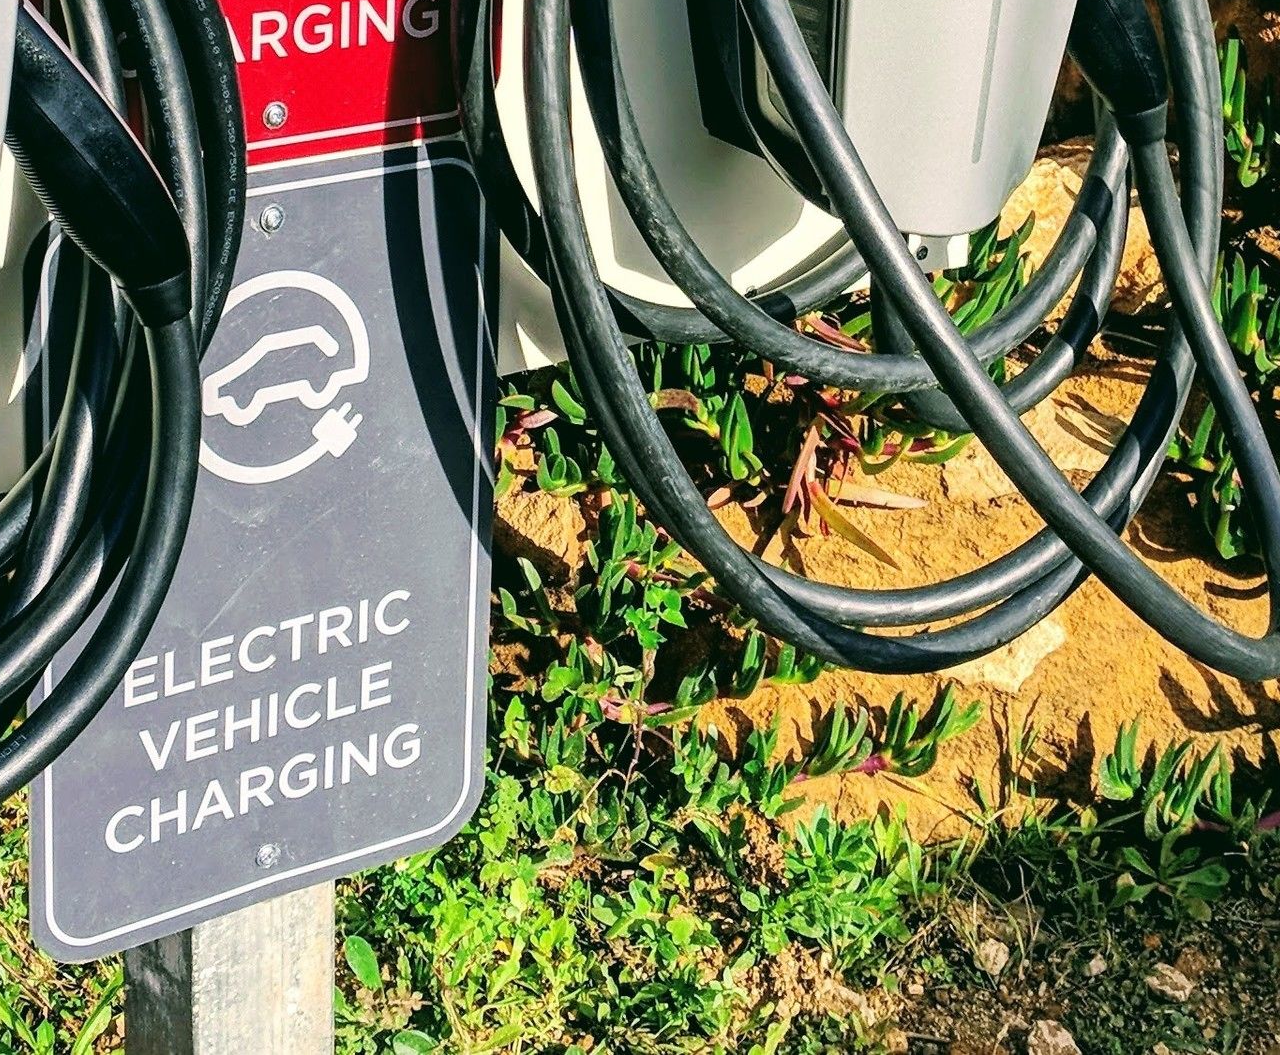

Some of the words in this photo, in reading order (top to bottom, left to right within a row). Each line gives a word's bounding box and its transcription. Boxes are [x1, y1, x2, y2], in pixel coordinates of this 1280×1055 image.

[123, 589, 412, 708] ELECTRIC
[139, 660, 394, 772] VEHICLE
[104, 722, 423, 854] CHARGING
